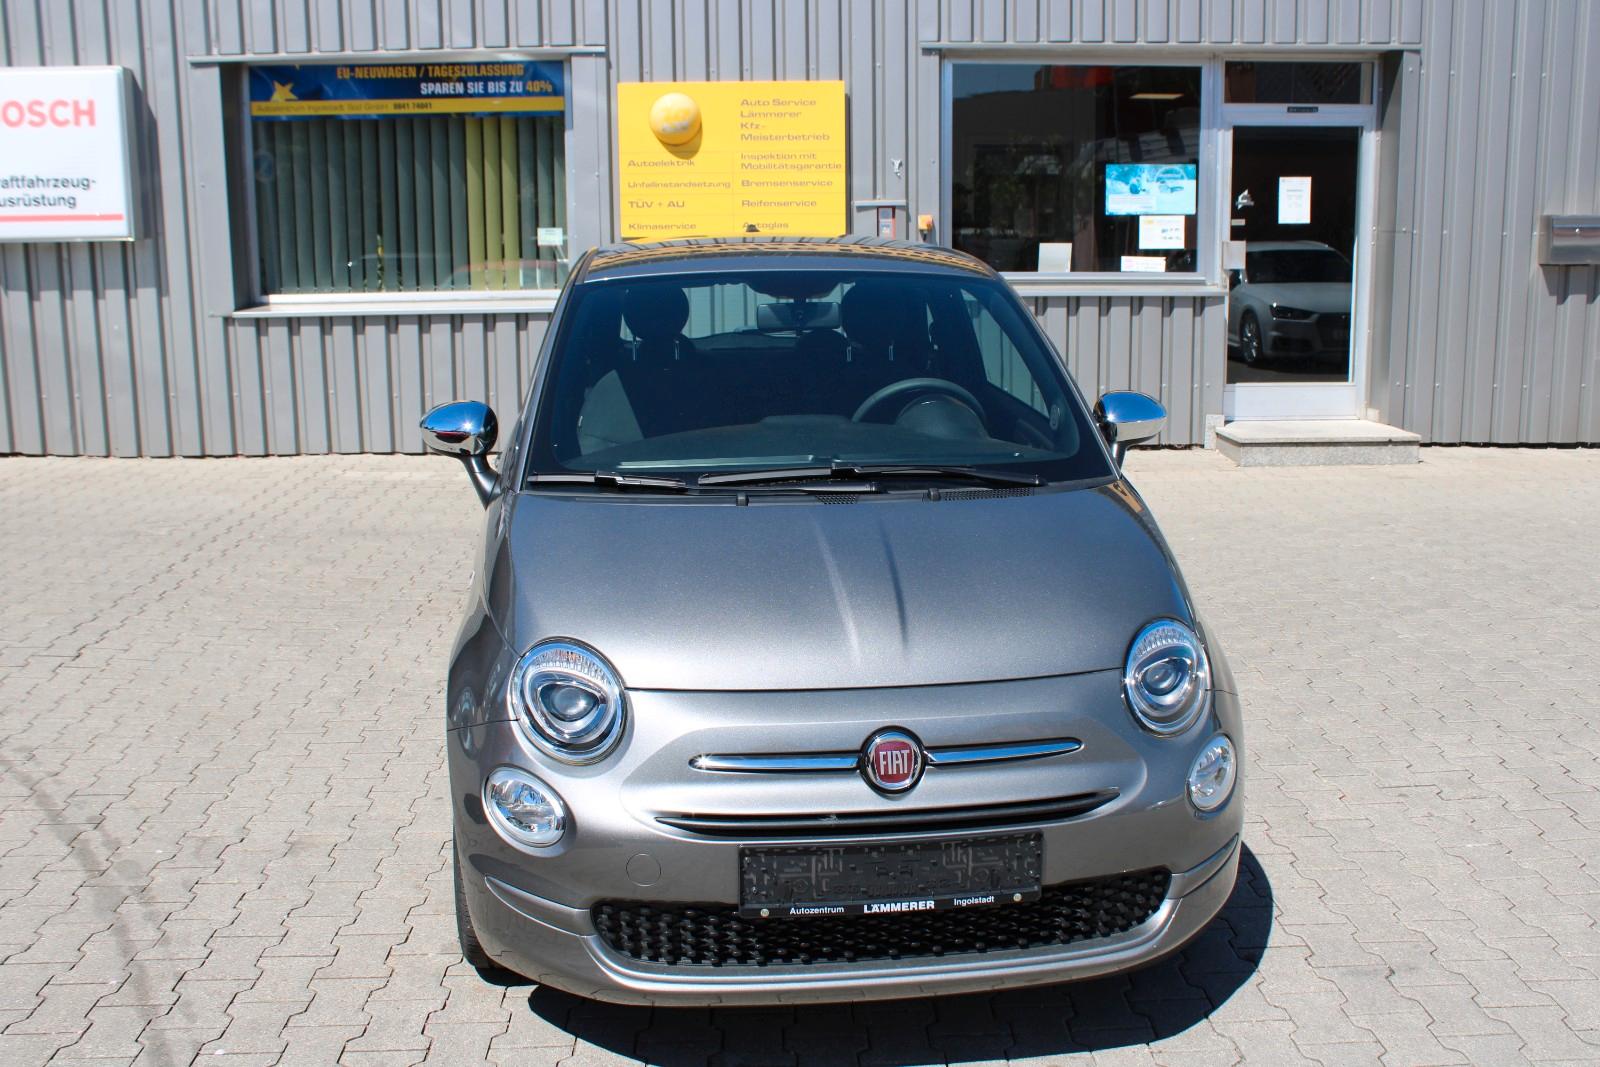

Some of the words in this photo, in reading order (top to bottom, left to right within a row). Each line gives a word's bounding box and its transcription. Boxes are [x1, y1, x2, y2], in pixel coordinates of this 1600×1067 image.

[336, 65, 417, 79] EU-NEUWAGEN
[428, 63, 525, 78] TAGESZULASSUNG
[420, 82, 464, 95] SPAREN
[467, 81, 485, 94] SIE
[487, 81, 506, 93] BIS
[508, 80, 524, 93] ZU
[525, 80, 553, 93] 40%
[740, 98, 769, 107] Auto
[772, 98, 817, 107] Service
[740, 110, 802, 118] Lämmerer
[740, 122, 766, 130] Kfz-
[740, 133, 831, 142] Meisterbetrieb
[740, 152, 798, 162] Inspektion
[799, 152, 817, 161] mit
[627, 159, 695, 168] Autoelektrik
[740, 162, 842, 172] Mobilitätsgarantie
[0, 175, 96, 191] aftfahrzeug-
[741, 179, 833, 188] Bremsenservice
[628, 199, 654, 209] TÜV
[667, 200, 686, 209] AU
[741, 199, 817, 208] Reifenservice
[628, 222, 697, 231] Klimaservice
[742, 221, 789, 231] Atoglas
[879, 748, 911, 776] FIAT
[789, 905, 845, 916] Autozentrum
[863, 900, 935, 914] LÄMMERER
[953, 895, 995, 907] Ingolstadt
